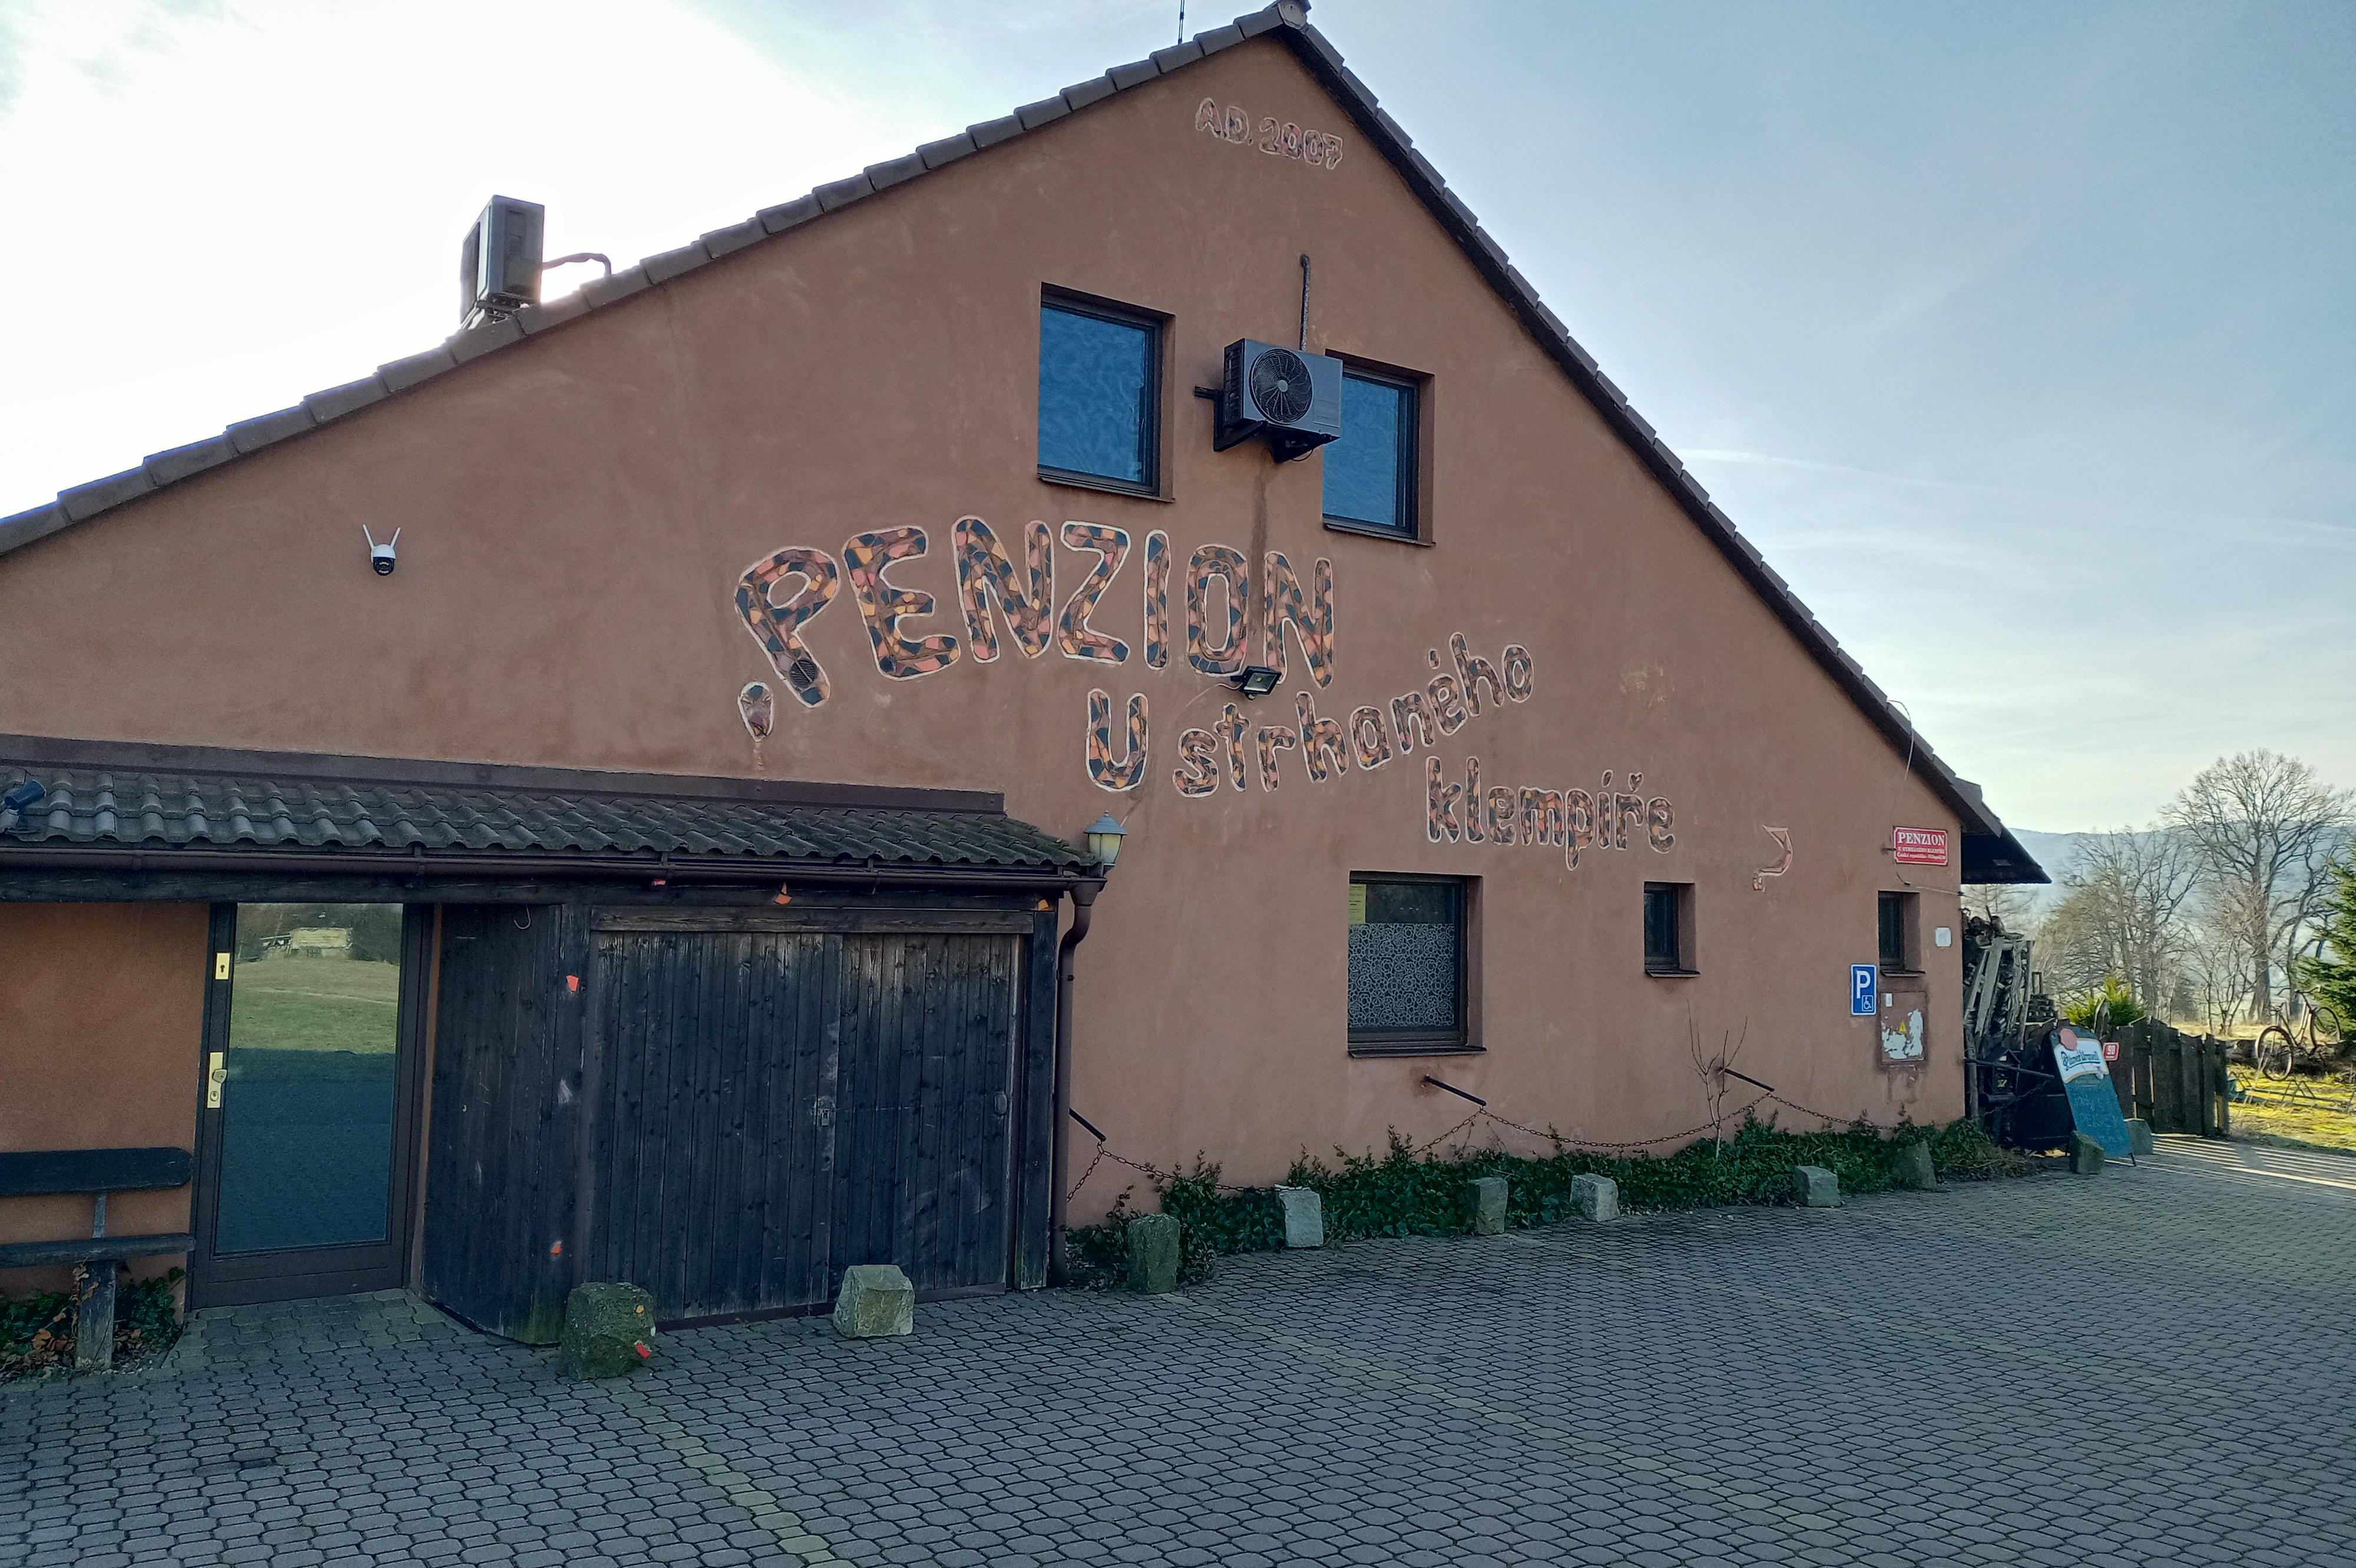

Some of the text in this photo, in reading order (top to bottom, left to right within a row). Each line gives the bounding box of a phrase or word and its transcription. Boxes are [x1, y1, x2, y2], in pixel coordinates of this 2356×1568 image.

[1259, 117, 1343, 170] 2007
[734, 516, 1333, 709] PENZION
[1086, 633, 1534, 798] U strhaného
[1425, 756, 1675, 871] klempíře
[1897, 832, 1945, 845] PENZION
[1856, 970, 1871, 999] P
